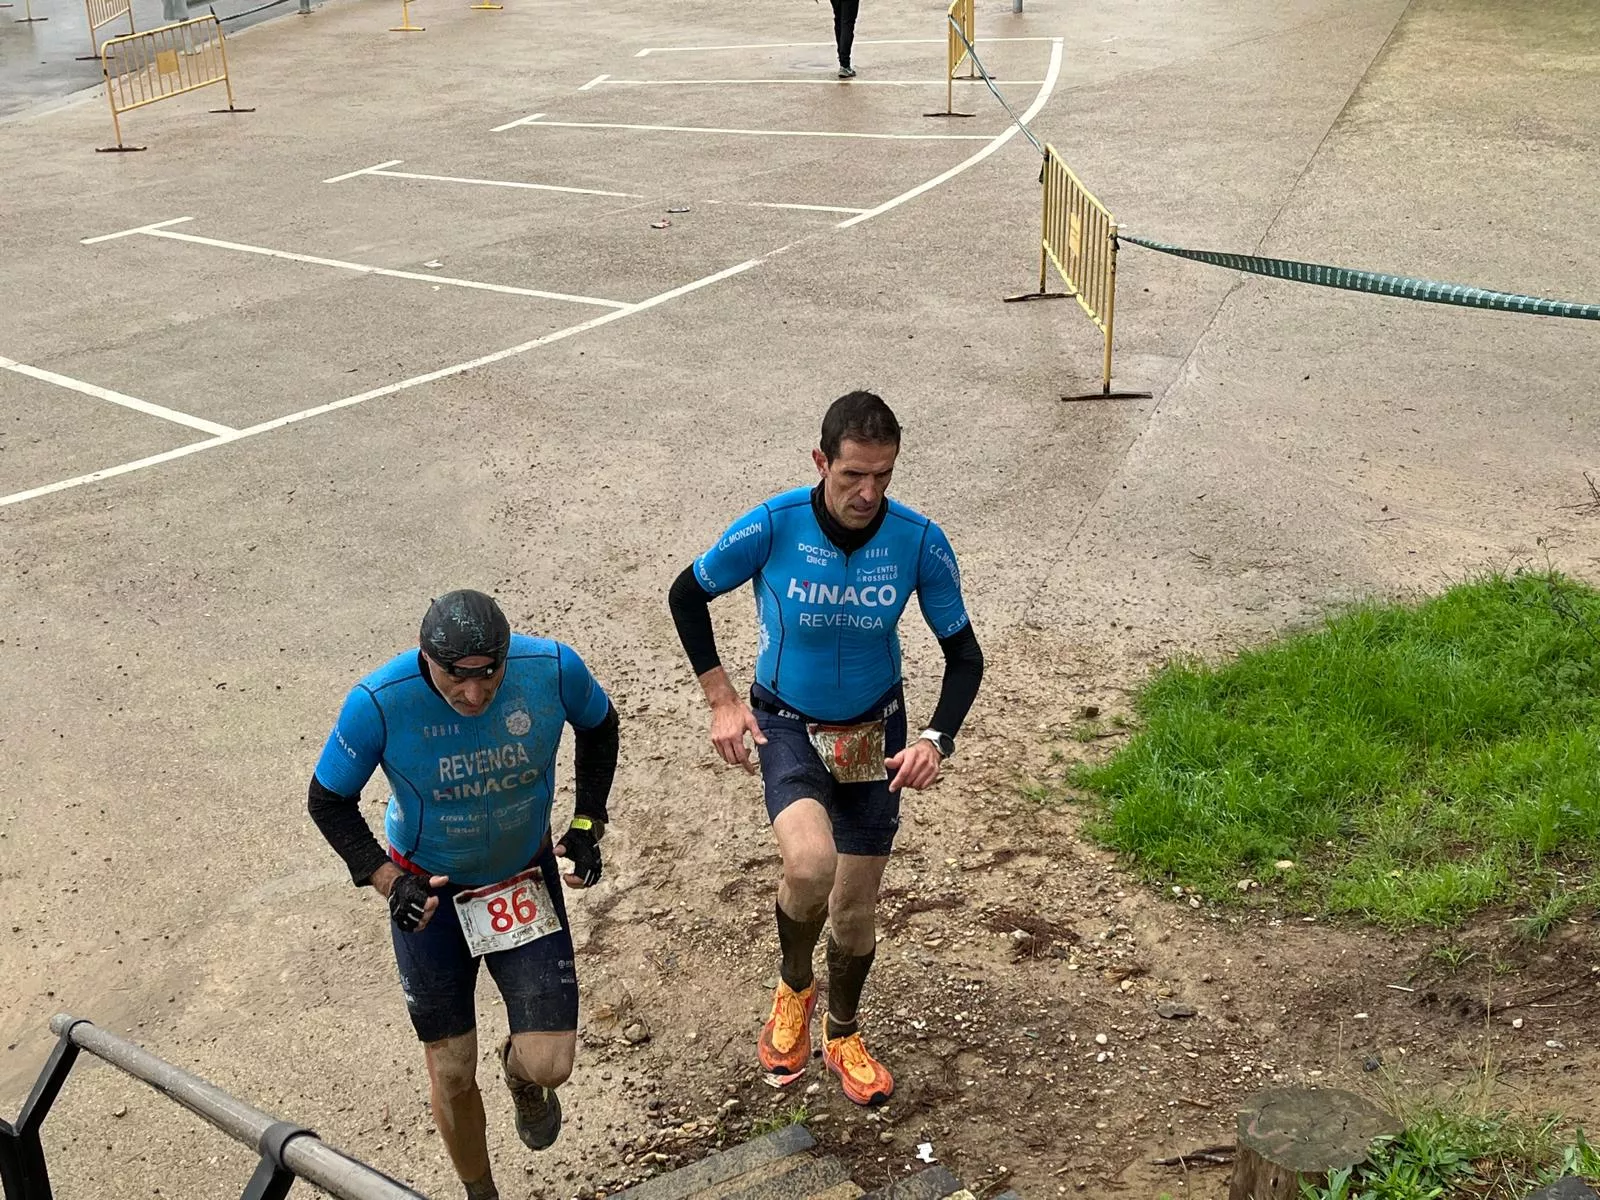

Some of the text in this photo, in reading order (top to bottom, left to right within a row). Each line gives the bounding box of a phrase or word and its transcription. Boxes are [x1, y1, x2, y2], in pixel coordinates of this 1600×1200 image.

[798, 543, 838, 559] DOCTOR
[806, 555, 828, 567] BIKE
[799, 613, 884, 629] REVENGA
[439, 742, 531, 783] REVENGA
[487, 886, 538, 933] 86
